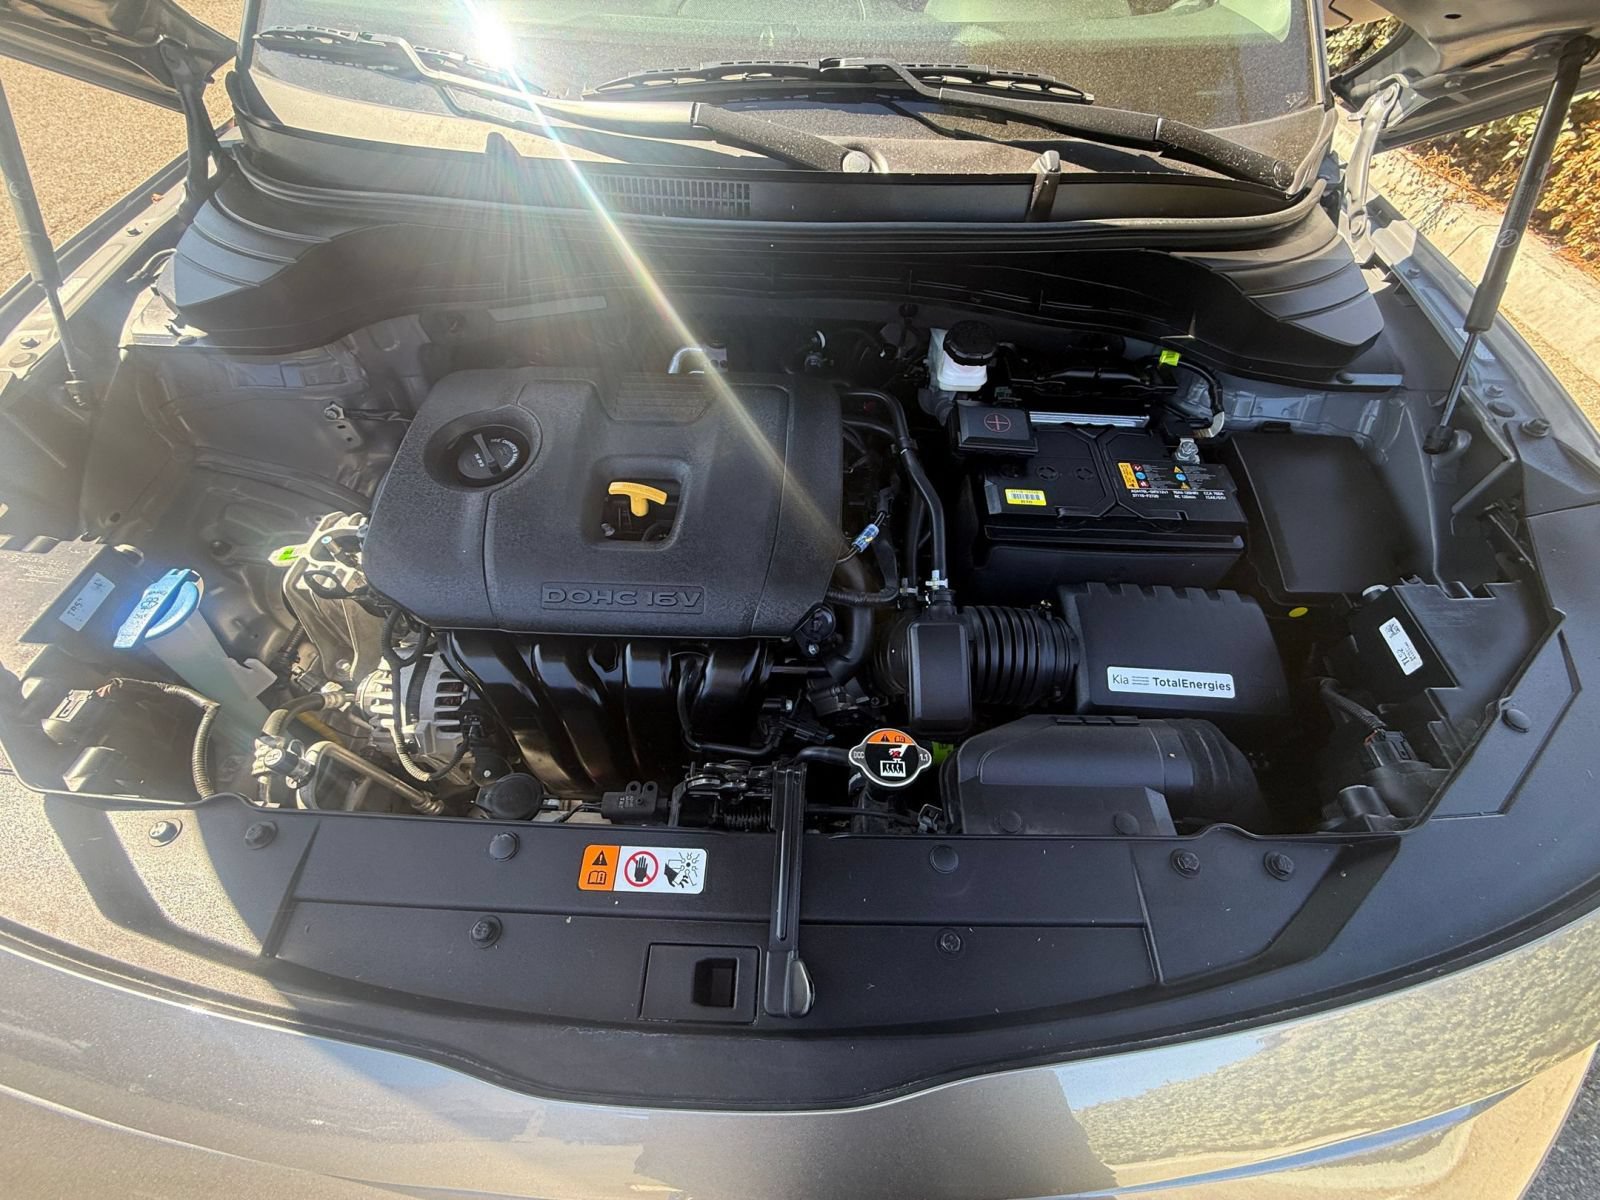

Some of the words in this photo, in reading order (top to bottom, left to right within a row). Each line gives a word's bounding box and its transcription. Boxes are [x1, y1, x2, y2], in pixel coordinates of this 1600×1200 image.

[542, 587, 638, 606] DOHC
[647, 590, 701, 608] 16V
[1112, 673, 1129, 685] Kia
[1152, 676, 1232, 692] TotalEnergies
